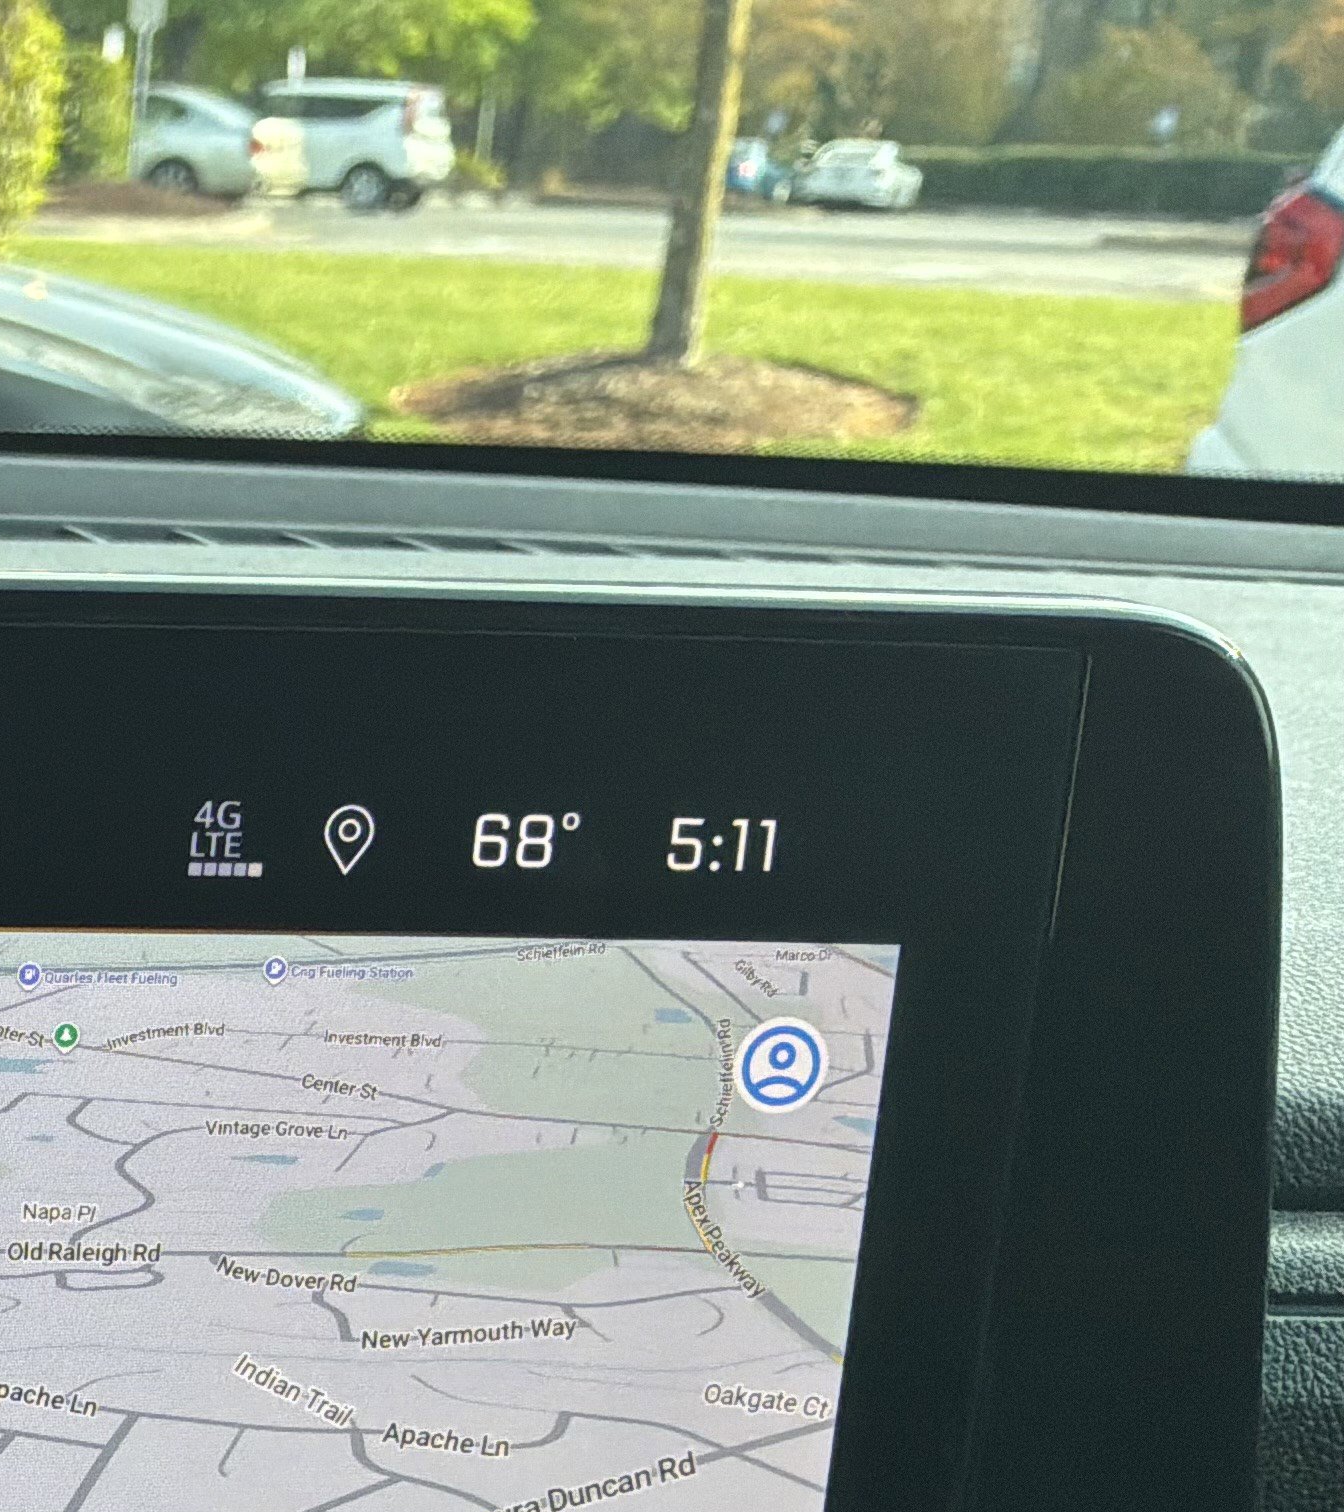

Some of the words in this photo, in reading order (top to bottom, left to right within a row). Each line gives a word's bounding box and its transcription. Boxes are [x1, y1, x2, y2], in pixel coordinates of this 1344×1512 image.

[194, 800, 242, 829] 4G
[189, 832, 243, 859] LTE
[471, 813, 581, 869] 68°
[665, 817, 779, 873] 5:11
[588, 944, 606, 956] Rd
[131, 972, 178, 987] Fueling
[319, 966, 365, 980] Fueling
[369, 967, 413, 979] Station
[760, 981, 779, 998] Rd
[29, 1032, 45, 1048] St
[108, 1027, 190, 1050] Investment
[194, 1024, 225, 1037] Blvd
[323, 1031, 406, 1047] Investment
[410, 1034, 442, 1049] Blvd
[718, 1018, 732, 1040] Rd
[301, 1074, 356, 1096] Center
[359, 1084, 377, 1100] St
[205, 1120, 270, 1138] Vintage
[275, 1121, 323, 1136] Grove
[328, 1126, 348, 1140] Ln
[23, 1203, 73, 1223] Napa
[79, 1206, 97, 1222] Pl
[683, 1179, 709, 1230] Apex
[708, 1226, 765, 1297] Peakway
[7, 1240, 45, 1260] Old
[50, 1240, 128, 1266] Raleigh
[132, 1242, 161, 1262] Rd
[215, 1257, 262, 1284] New
[266, 1267, 323, 1291] Dover
[328, 1275, 357, 1293] Rd
[361, 1331, 410, 1349] New
[416, 1322, 524, 1345] Yarmouth
[530, 1319, 576, 1339] Way
[233, 1353, 302, 1403] Indian
[302, 1389, 352, 1425] Trail
[704, 1384, 797, 1415] Oakgate
[804, 1398, 829, 1417] Ct
[69, 1395, 98, 1416] Ln
[382, 1424, 473, 1456] Apache
[480, 1434, 510, 1456] Ln
[547, 1468, 653, 1512] Duncan
[658, 1452, 698, 1481] Rd
